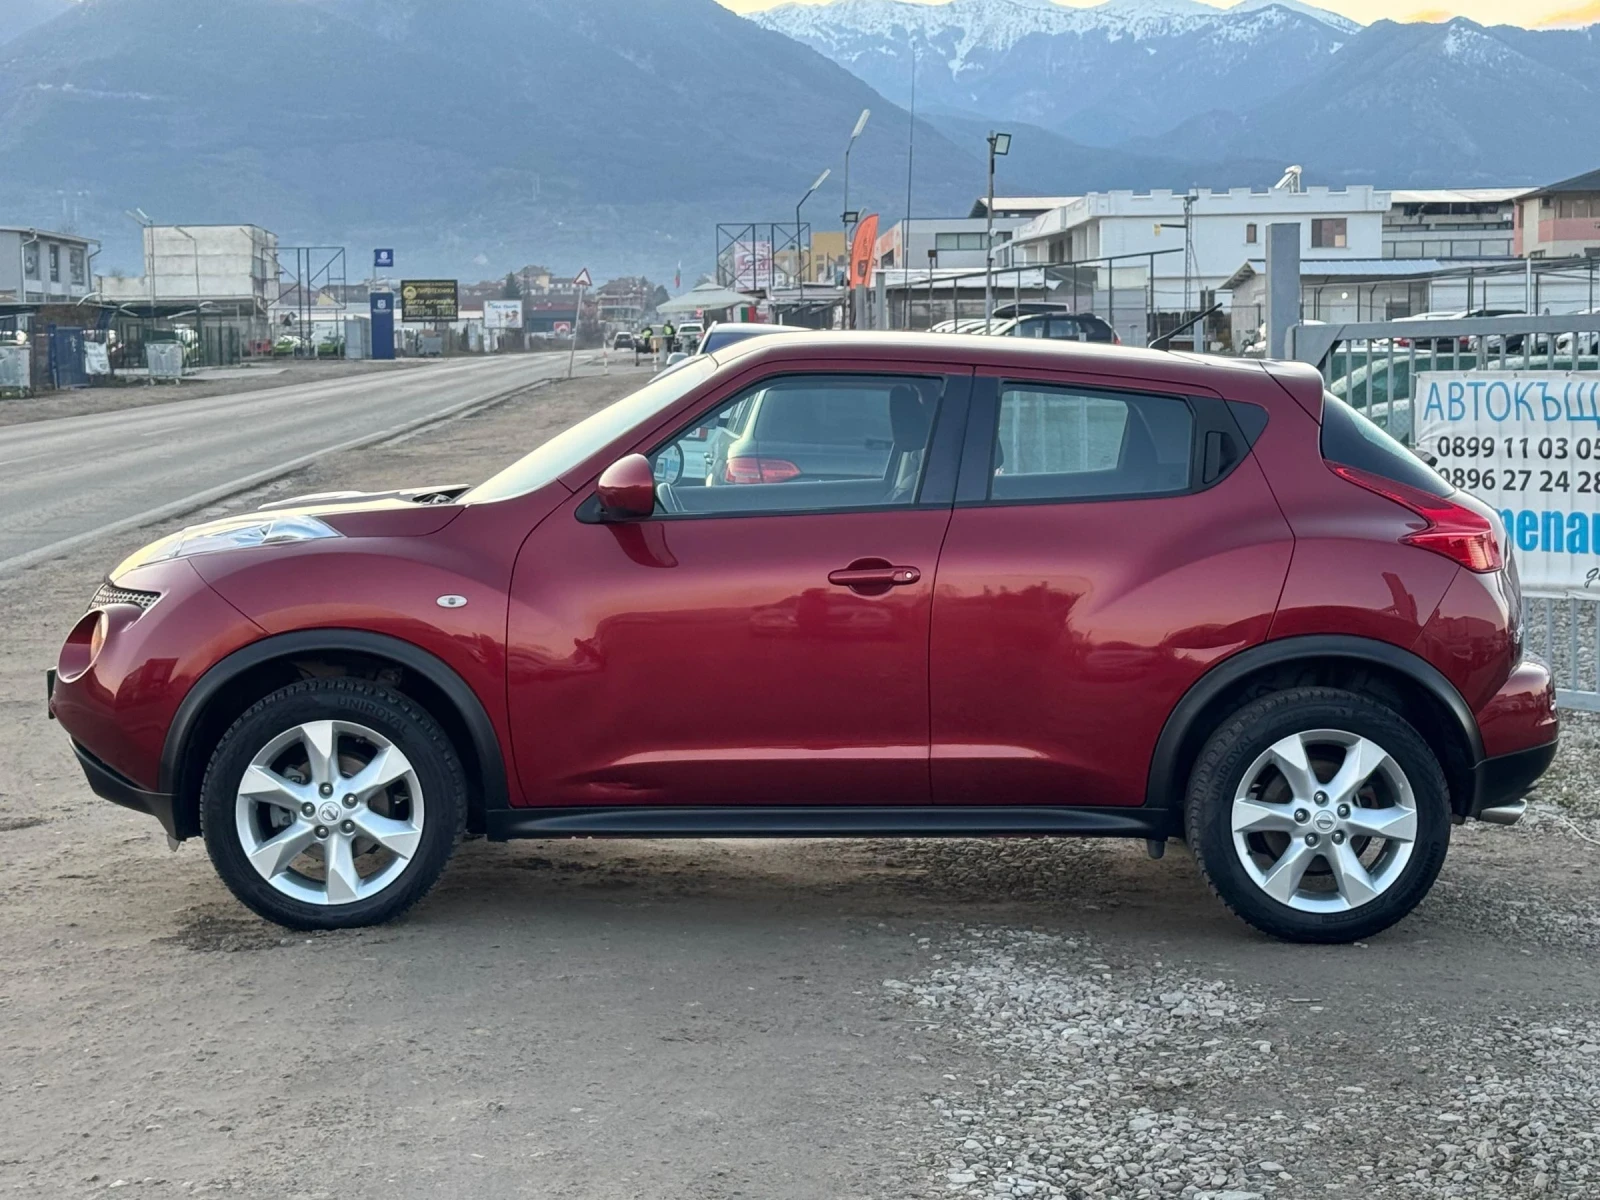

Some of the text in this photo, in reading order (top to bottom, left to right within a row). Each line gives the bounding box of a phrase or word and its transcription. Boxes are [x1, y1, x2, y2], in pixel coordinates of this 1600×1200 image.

[1437, 436, 1495, 459] 0899
[1503, 437, 1529, 459] 11
[1538, 437, 1569, 460] 03
[1438, 467, 1496, 490] 0896
[1502, 469, 1532, 492] 27
[1539, 470, 1570, 493] 24
[338, 697, 408, 735] UNIROYAL
[1210, 735, 1254, 802] UNIROYAL
